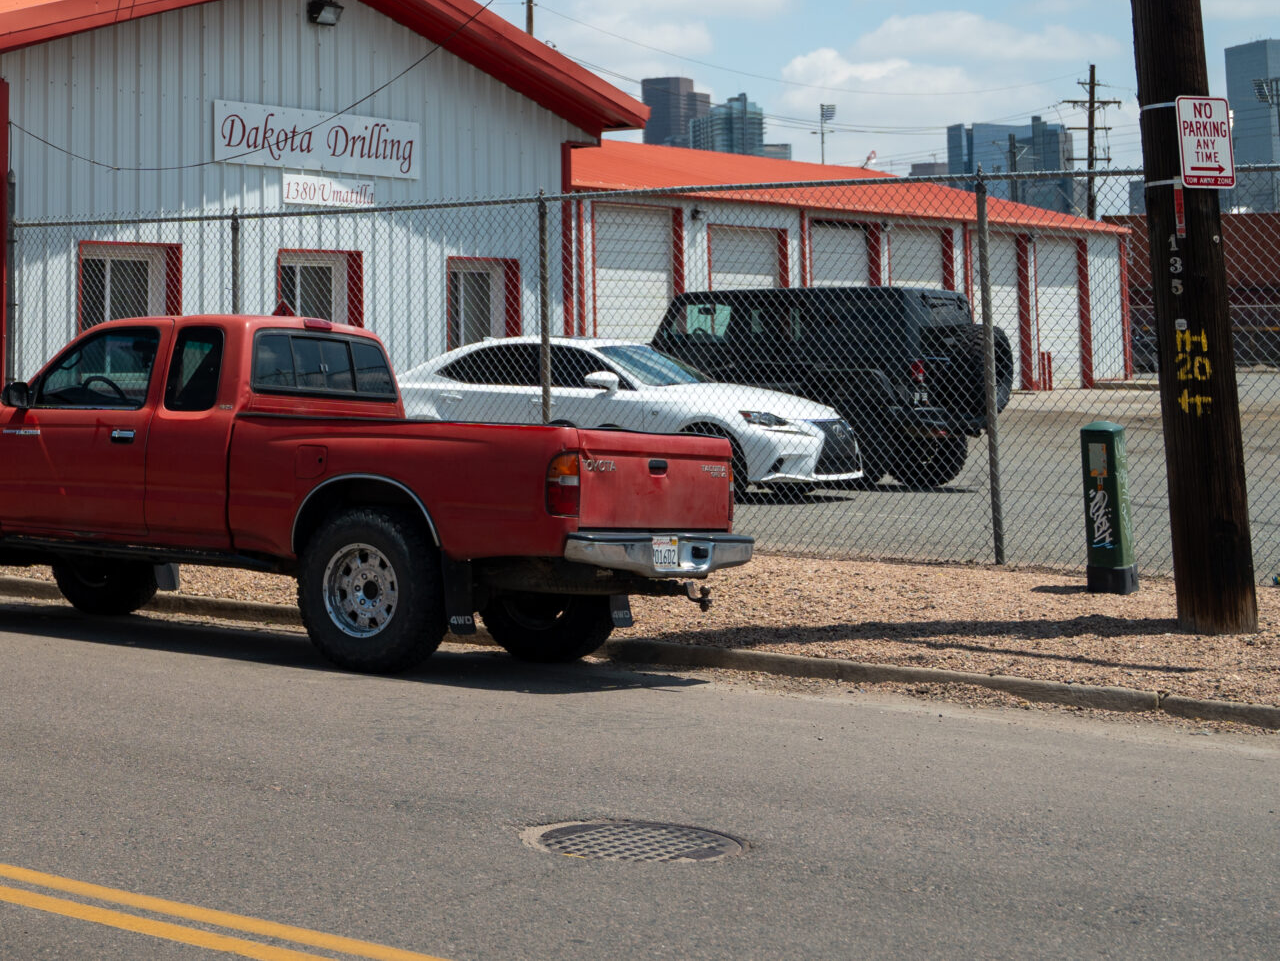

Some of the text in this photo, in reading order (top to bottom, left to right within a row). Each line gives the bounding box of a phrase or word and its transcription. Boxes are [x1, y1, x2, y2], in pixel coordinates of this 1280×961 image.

[1193, 102, 1213, 119] NO
[1182, 120, 1227, 138] PARKING
[221, 113, 414, 174] Dakota Drilling
[1196, 139, 1216, 150] ANY
[1195, 151, 1219, 163] TIME
[1217, 177, 1233, 185] ZONE
[285, 181, 374, 205] 1380 Umatilla
[1175, 353, 1212, 381] 20
[581, 458, 617, 472] TOYOTA
[450, 615, 473, 625] 4WD
[612, 610, 630, 618] 4WD
